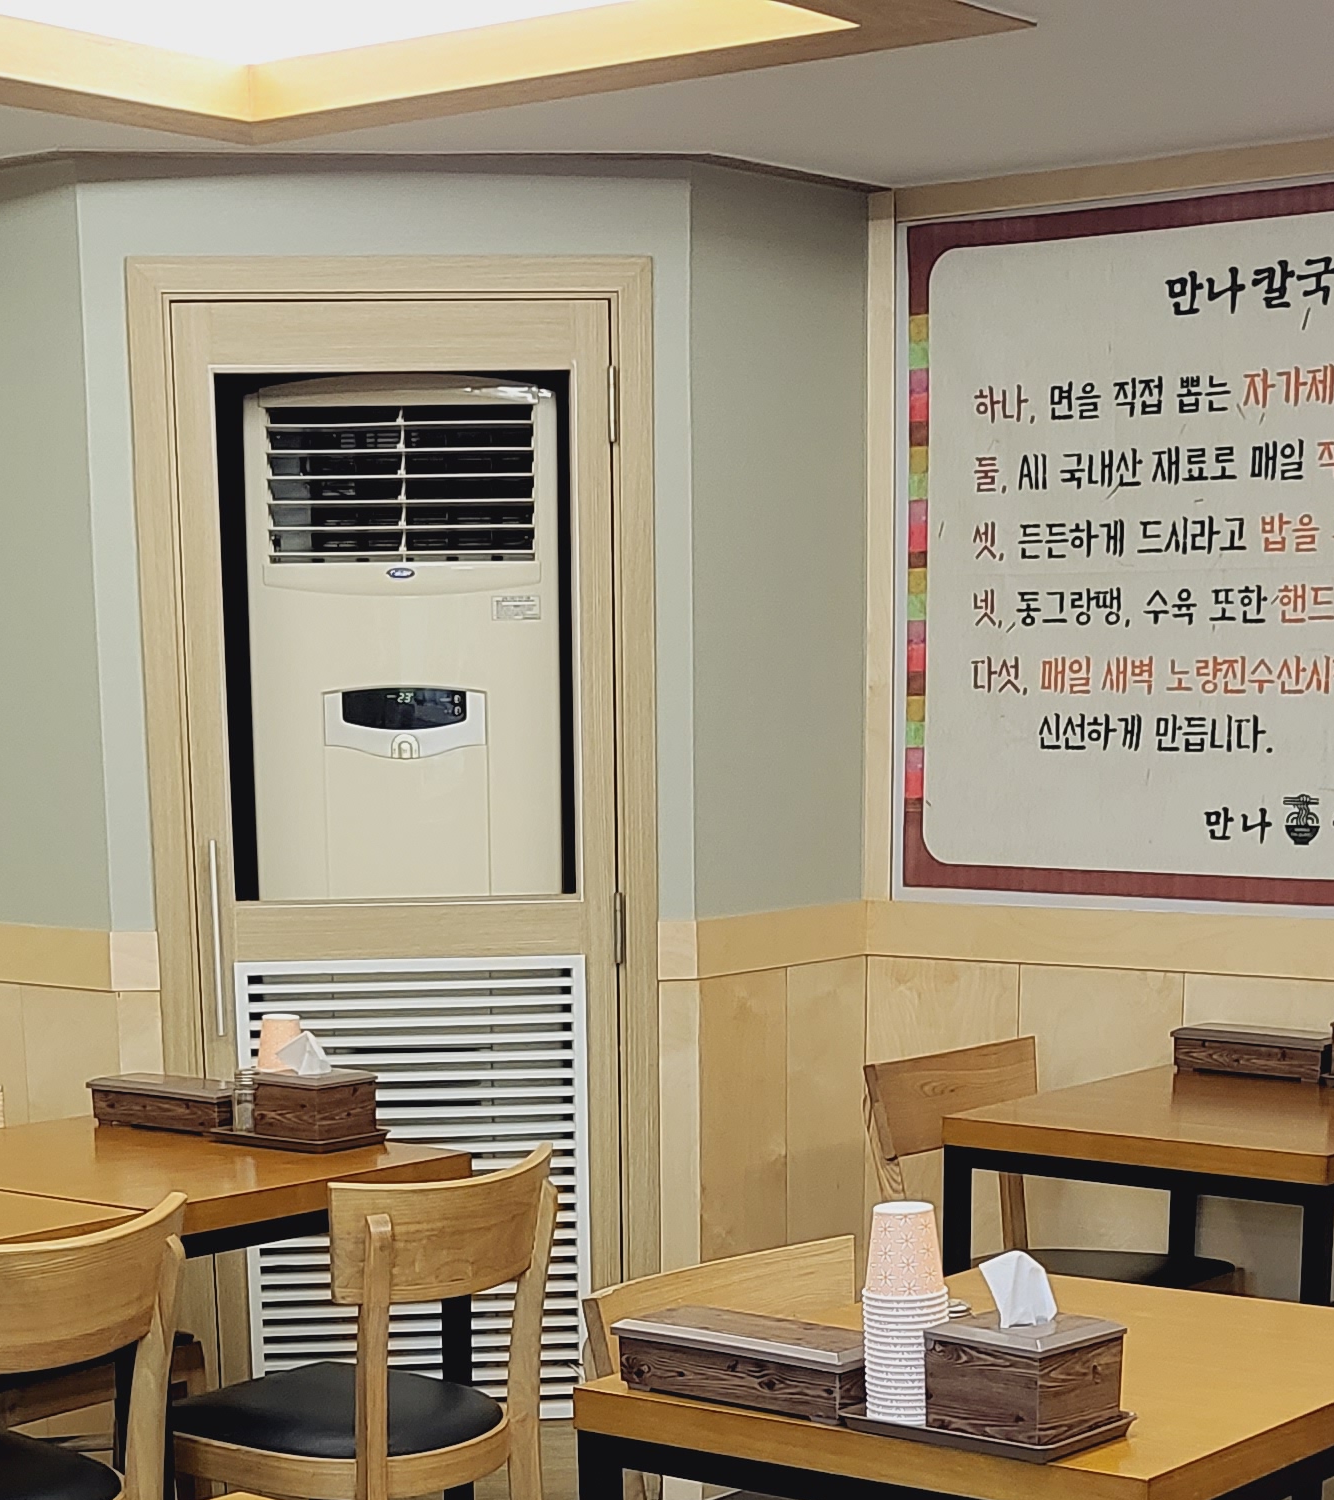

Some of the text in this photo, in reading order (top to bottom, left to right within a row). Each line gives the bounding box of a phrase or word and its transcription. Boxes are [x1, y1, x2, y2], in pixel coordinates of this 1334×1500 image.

[974, 384, 1035, 424] 하나,
[1050, 381, 1101, 420] 면을
[1113, 376, 1163, 418] 직접
[1177, 375, 1231, 413] 뽑는
[974, 457, 1006, 494] 둘,
[1060, 448, 1143, 490] 국내산
[1152, 446, 1237, 485] 재료로
[1250, 439, 1304, 481] 매일
[973, 521, 1004, 561] 셋,
[1018, 519, 1124, 559] 든든하게
[1137, 515, 1247, 555] 드시라고
[1261, 513, 1319, 552] 밥을
[974, 589, 1002, 628] 넷,
[1016, 587, 1130, 628] 동그랑땡,
[1143, 589, 1197, 625] 수육
[1209, 585, 1268, 624] 또한
[971, 656, 1027, 695] 다섯,
[1041, 656, 1091, 694] 매일
[1102, 656, 1153, 695] 새벽
[1039, 713, 1273, 753] 신선하게 만듭니다.
[1204, 807, 1272, 844] 만나
